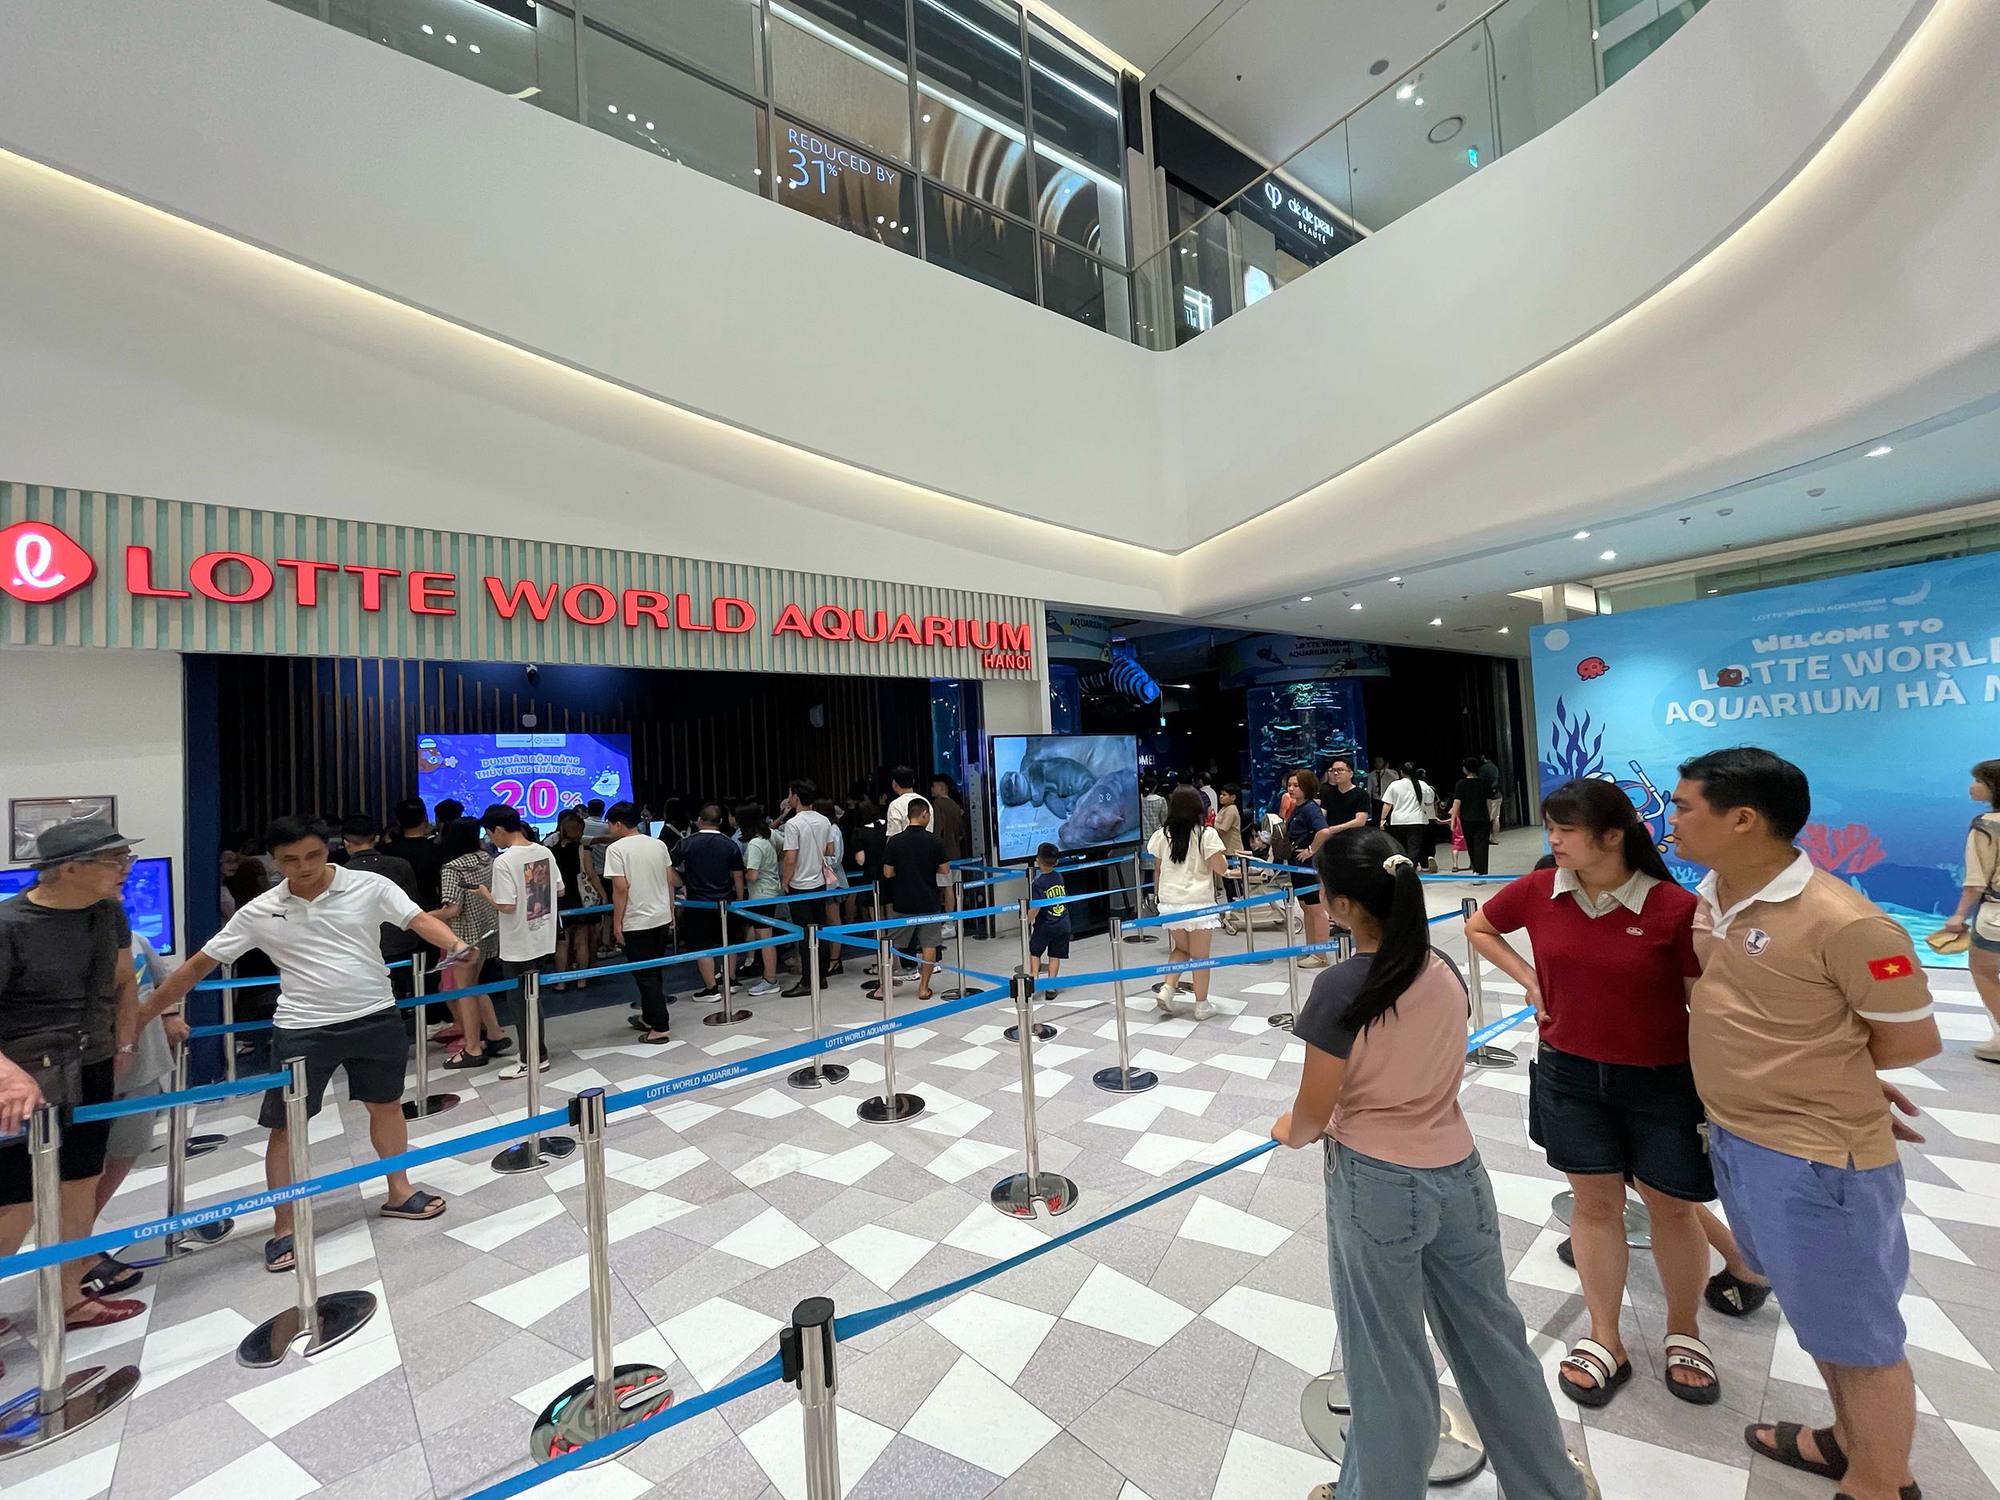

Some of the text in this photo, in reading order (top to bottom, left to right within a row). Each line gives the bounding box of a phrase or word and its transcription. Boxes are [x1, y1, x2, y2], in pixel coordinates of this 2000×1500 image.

[788, 127, 895, 186] REDUCED BY
[1314, 215, 1334, 238] peau
[126, 545, 1031, 651] LOTTE WORLD AQUARIUM
[1752, 617, 1944, 654] WELCOME TO
[982, 653, 1032, 670] HANOI
[1665, 685, 1880, 727] AQUARIUM
[1896, 671, 1967, 709] HÀ
[504, 764, 532, 775] CUNG
[825, 1021, 896, 1048] LOTTE WORLD AQUARIUM
[646, 1066, 740, 1098] LOTTE WORLD AQUARIUM
[134, 1186, 306, 1239] LOTTE WORLD AQUARIUM
